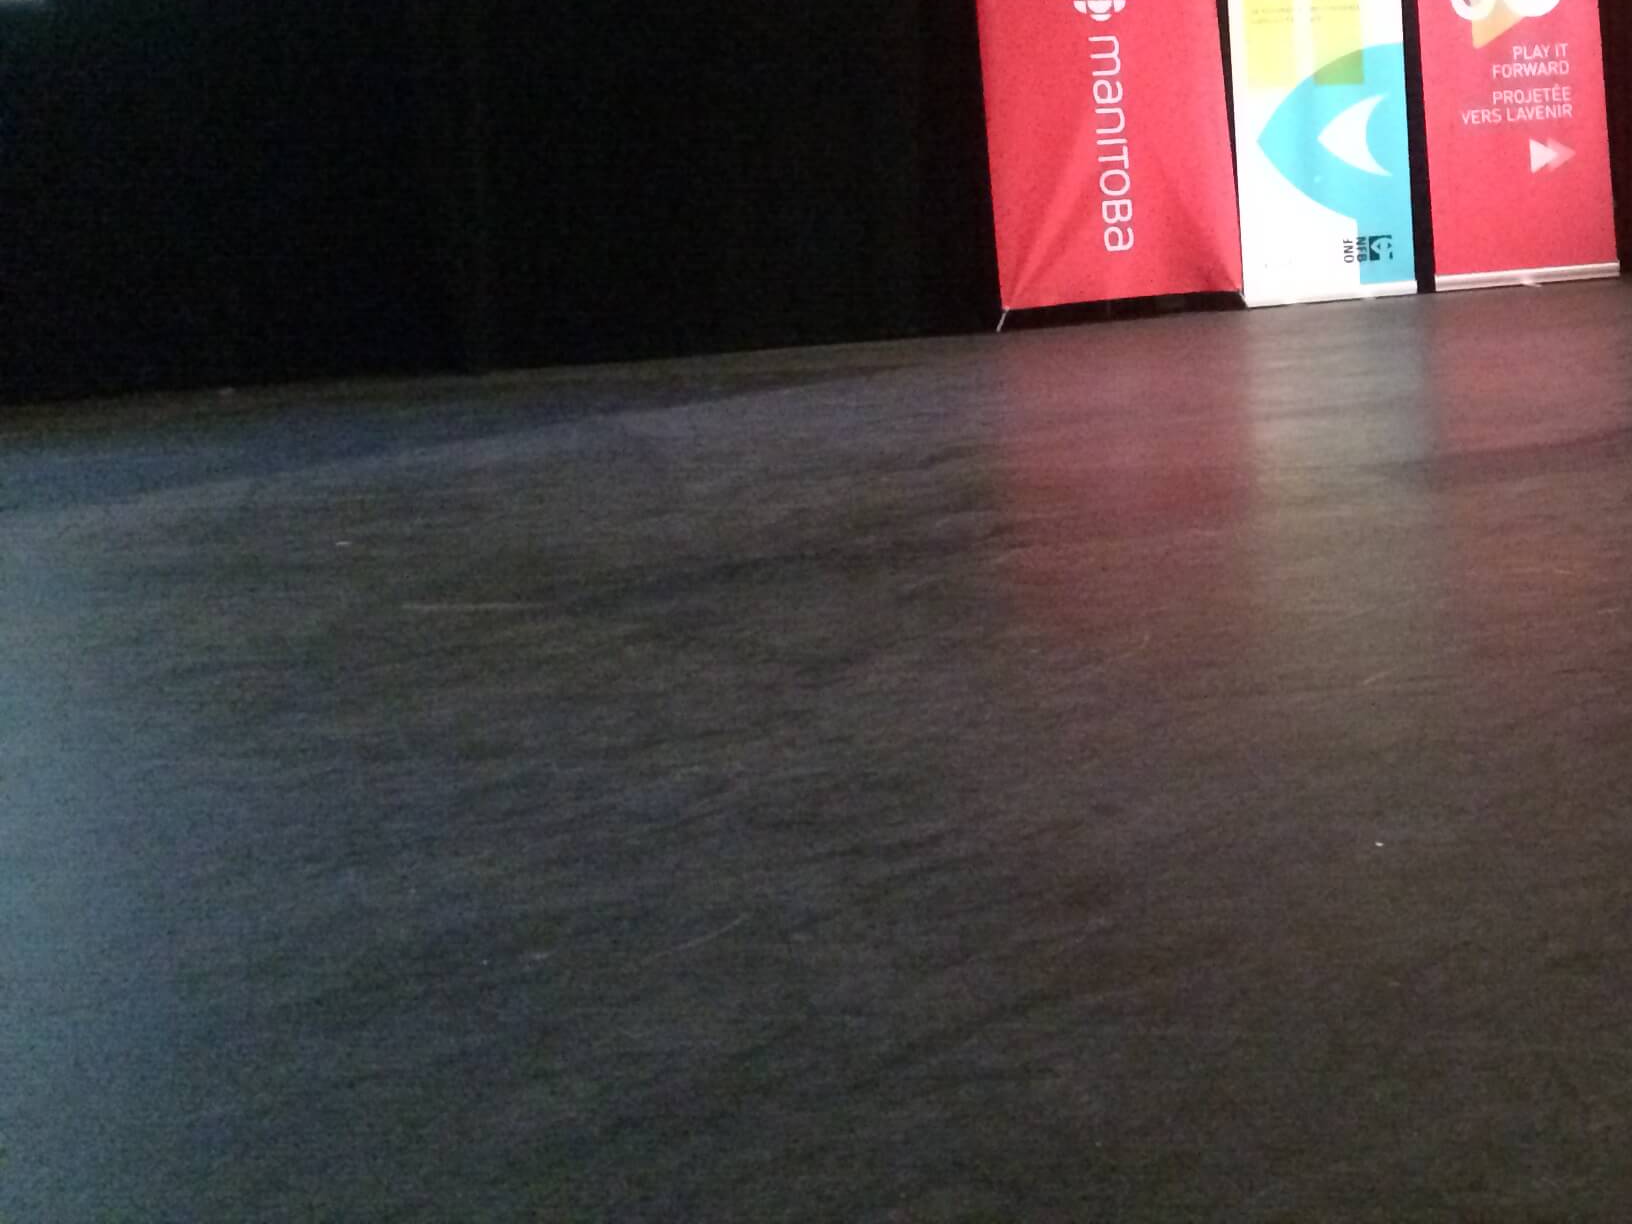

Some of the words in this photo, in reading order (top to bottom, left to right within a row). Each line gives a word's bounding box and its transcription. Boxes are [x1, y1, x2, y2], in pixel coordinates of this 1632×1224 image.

[1512, 44, 1550, 60] PLAY
[1554, 42, 1569, 57] IT
[1492, 59, 1570, 79] FORWARD
[1492, 83, 1572, 104] PROJETÉE
[1461, 107, 1502, 125] VERS
